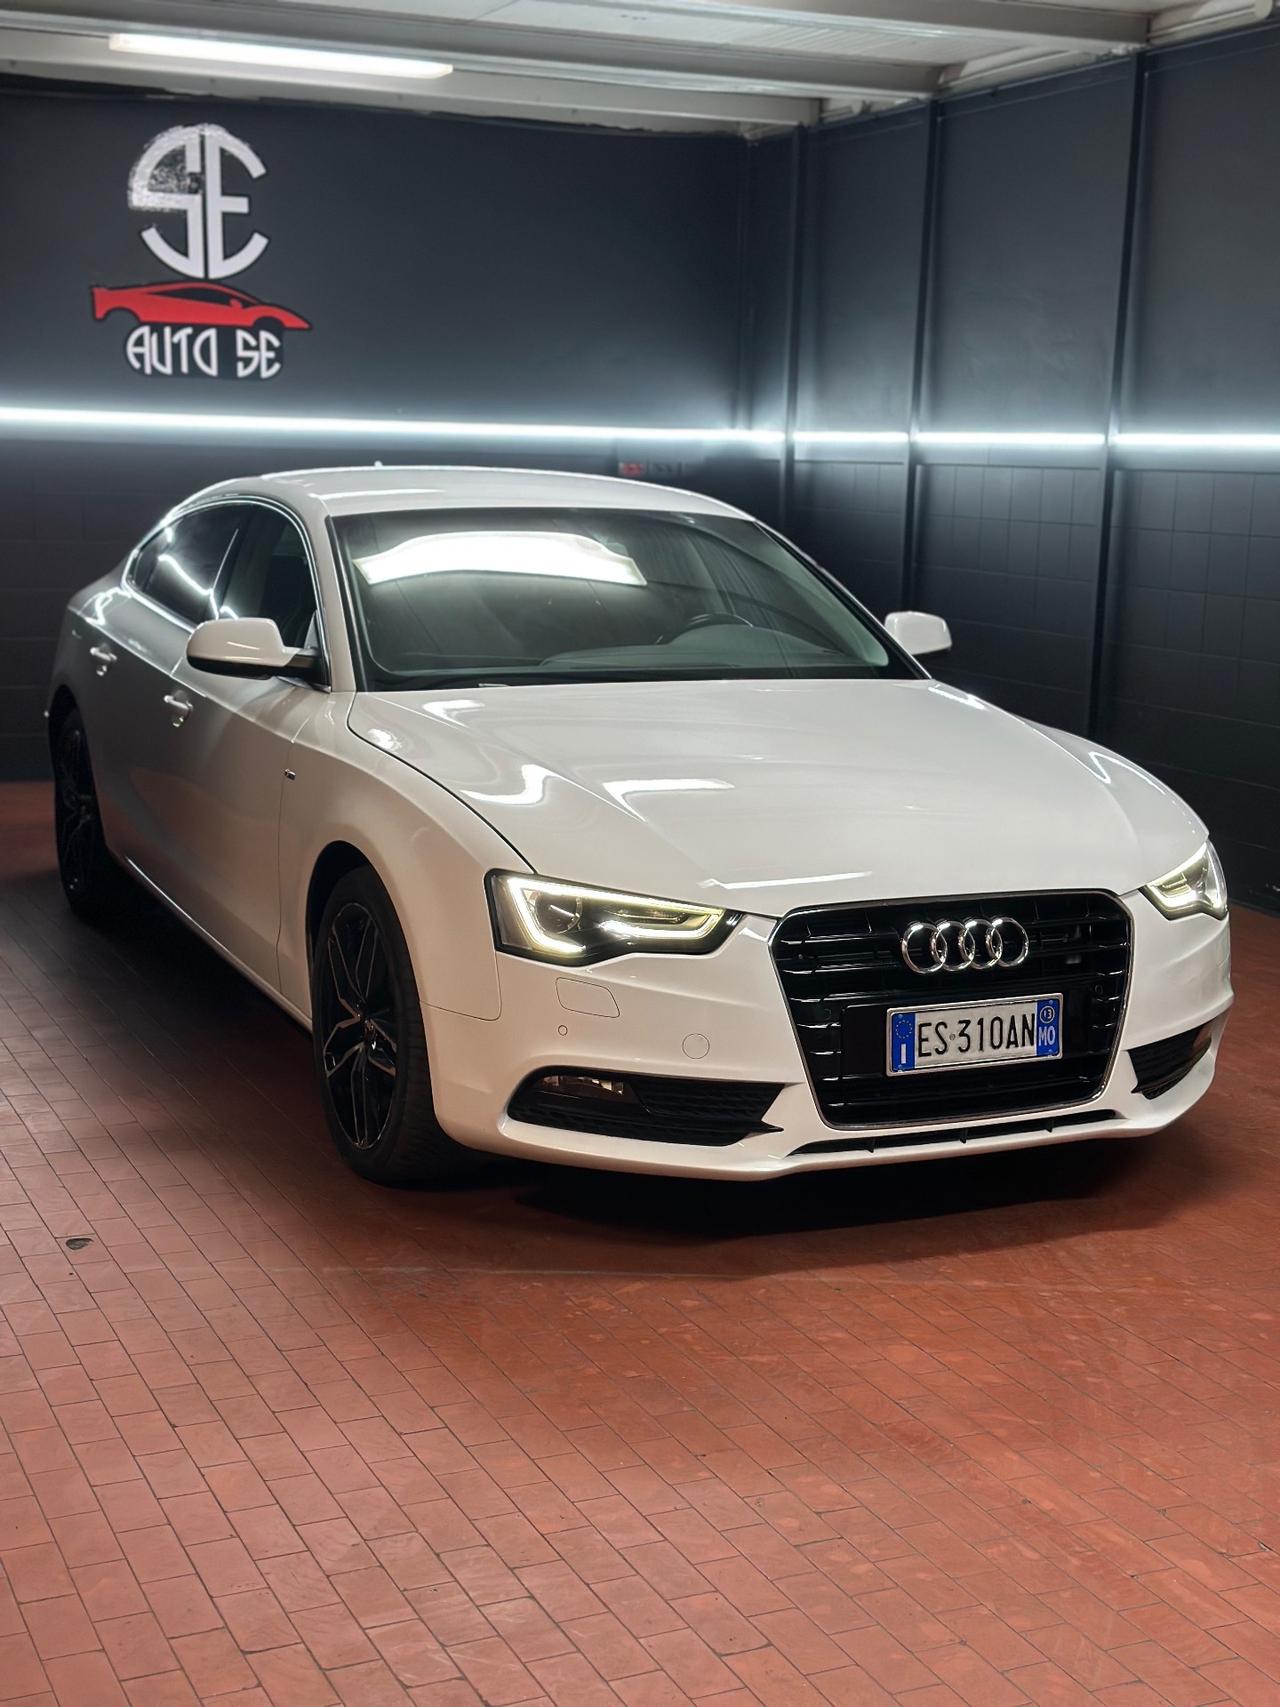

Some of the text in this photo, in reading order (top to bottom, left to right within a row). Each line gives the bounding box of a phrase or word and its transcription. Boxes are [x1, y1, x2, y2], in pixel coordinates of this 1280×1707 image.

[126, 325, 281, 379] AUTO SE
[1038, 1025, 1056, 1046] MO
